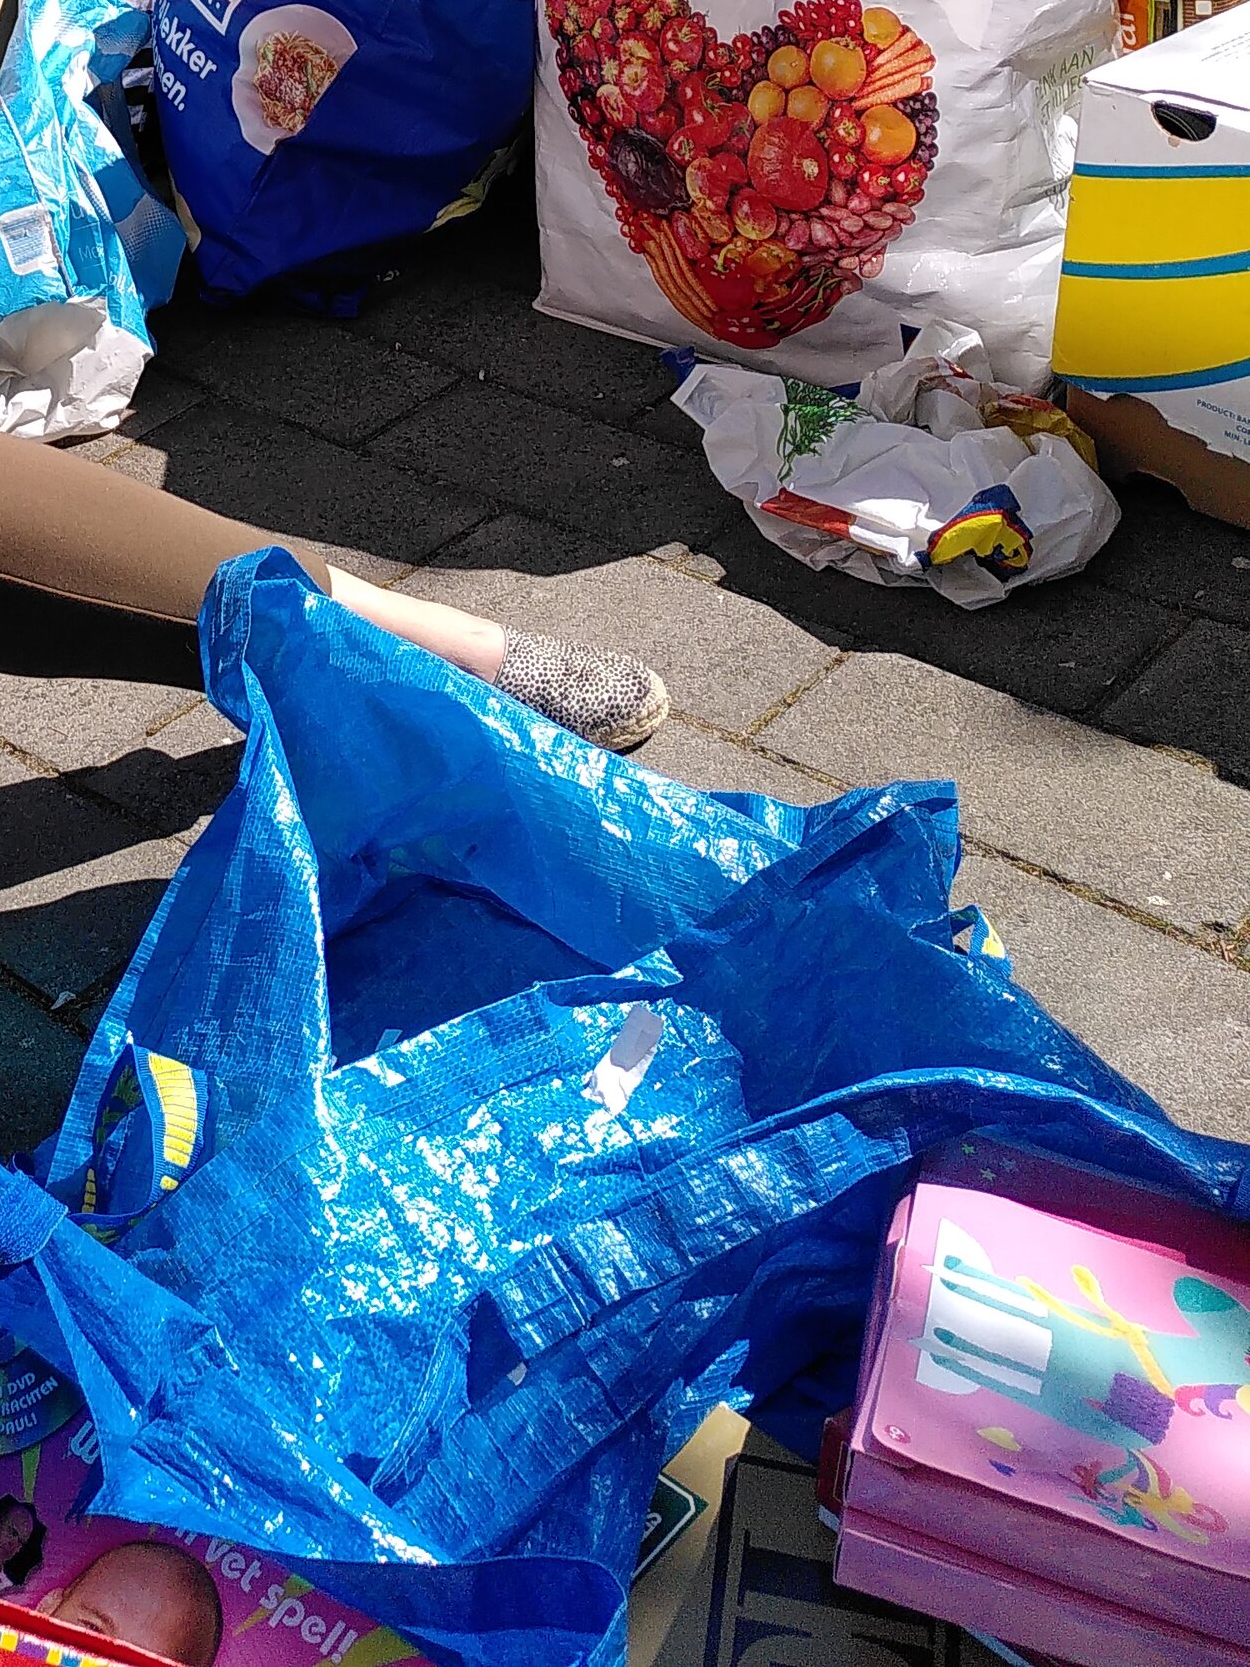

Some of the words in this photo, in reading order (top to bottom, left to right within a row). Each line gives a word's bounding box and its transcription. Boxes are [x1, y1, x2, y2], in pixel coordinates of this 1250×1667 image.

[1060, 45, 1095, 79] AAN
[1197, 399, 1236, 419] PRODUCT:
[7, 1372, 36, 1395] DVD
[205, 1539, 263, 1593] vet
[259, 1583, 359, 1664] spel!
